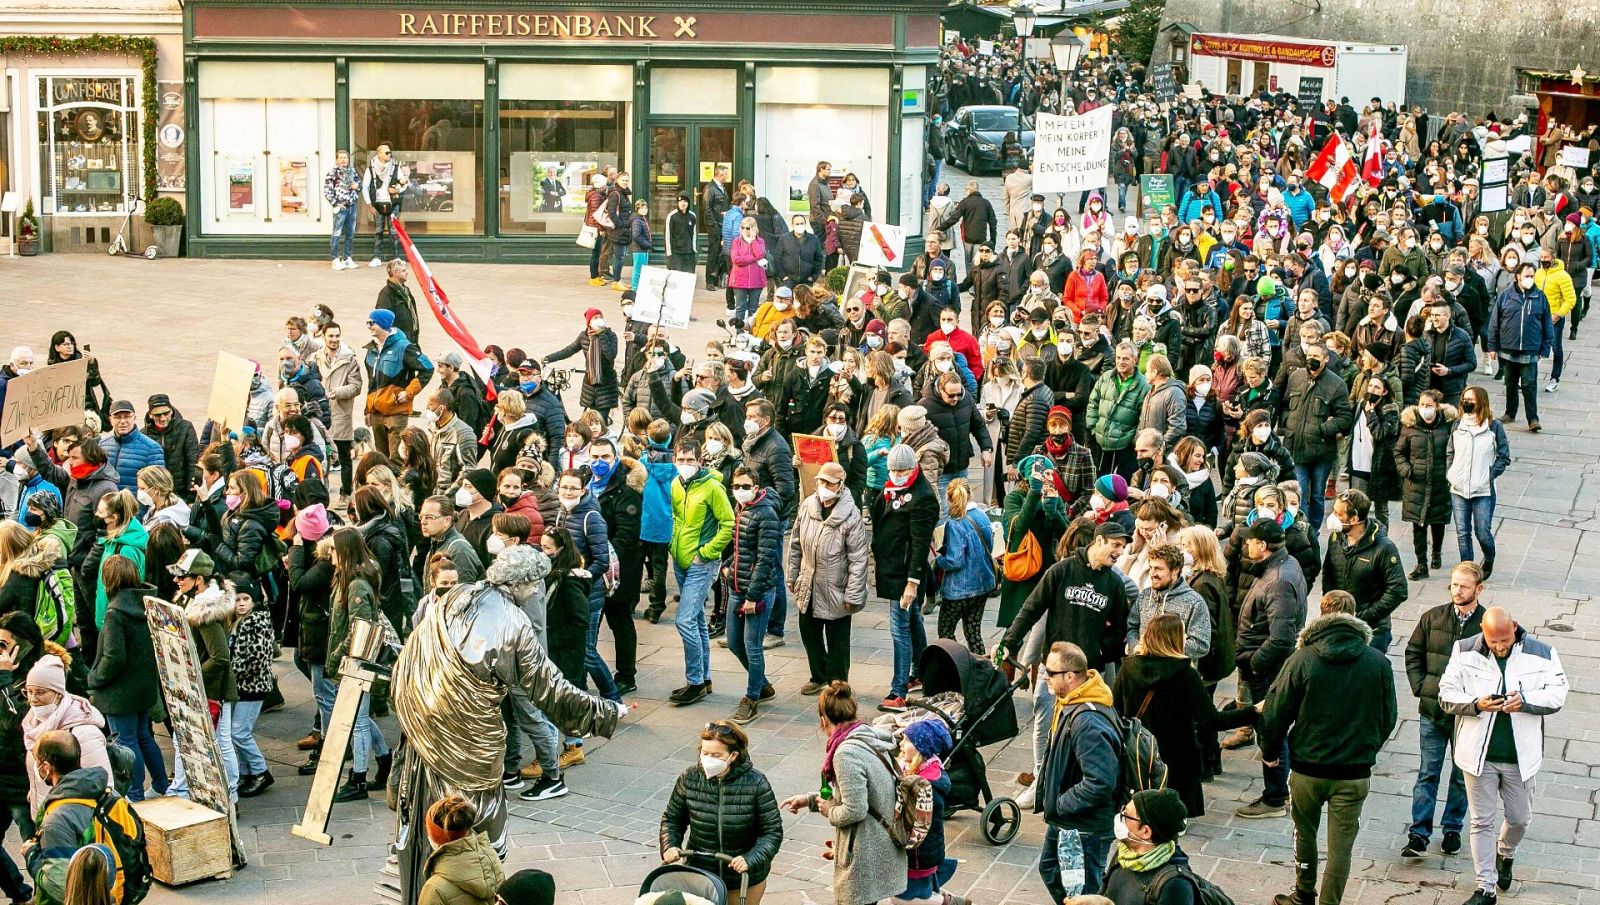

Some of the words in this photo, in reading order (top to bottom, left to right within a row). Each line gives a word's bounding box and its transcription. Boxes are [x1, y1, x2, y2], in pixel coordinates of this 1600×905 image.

[399, 13, 658, 37] RAIFFEISENBANK
[1239, 43, 1271, 55] KONTROLLE
[54, 82, 120, 101] CONFISERIE
[1038, 119, 1085, 130] IMPFEN
[1040, 133, 1063, 143] MEIN
[1057, 146, 1086, 157] MEINE
[1040, 158, 1107, 173] ENTSCHEIDUNG
